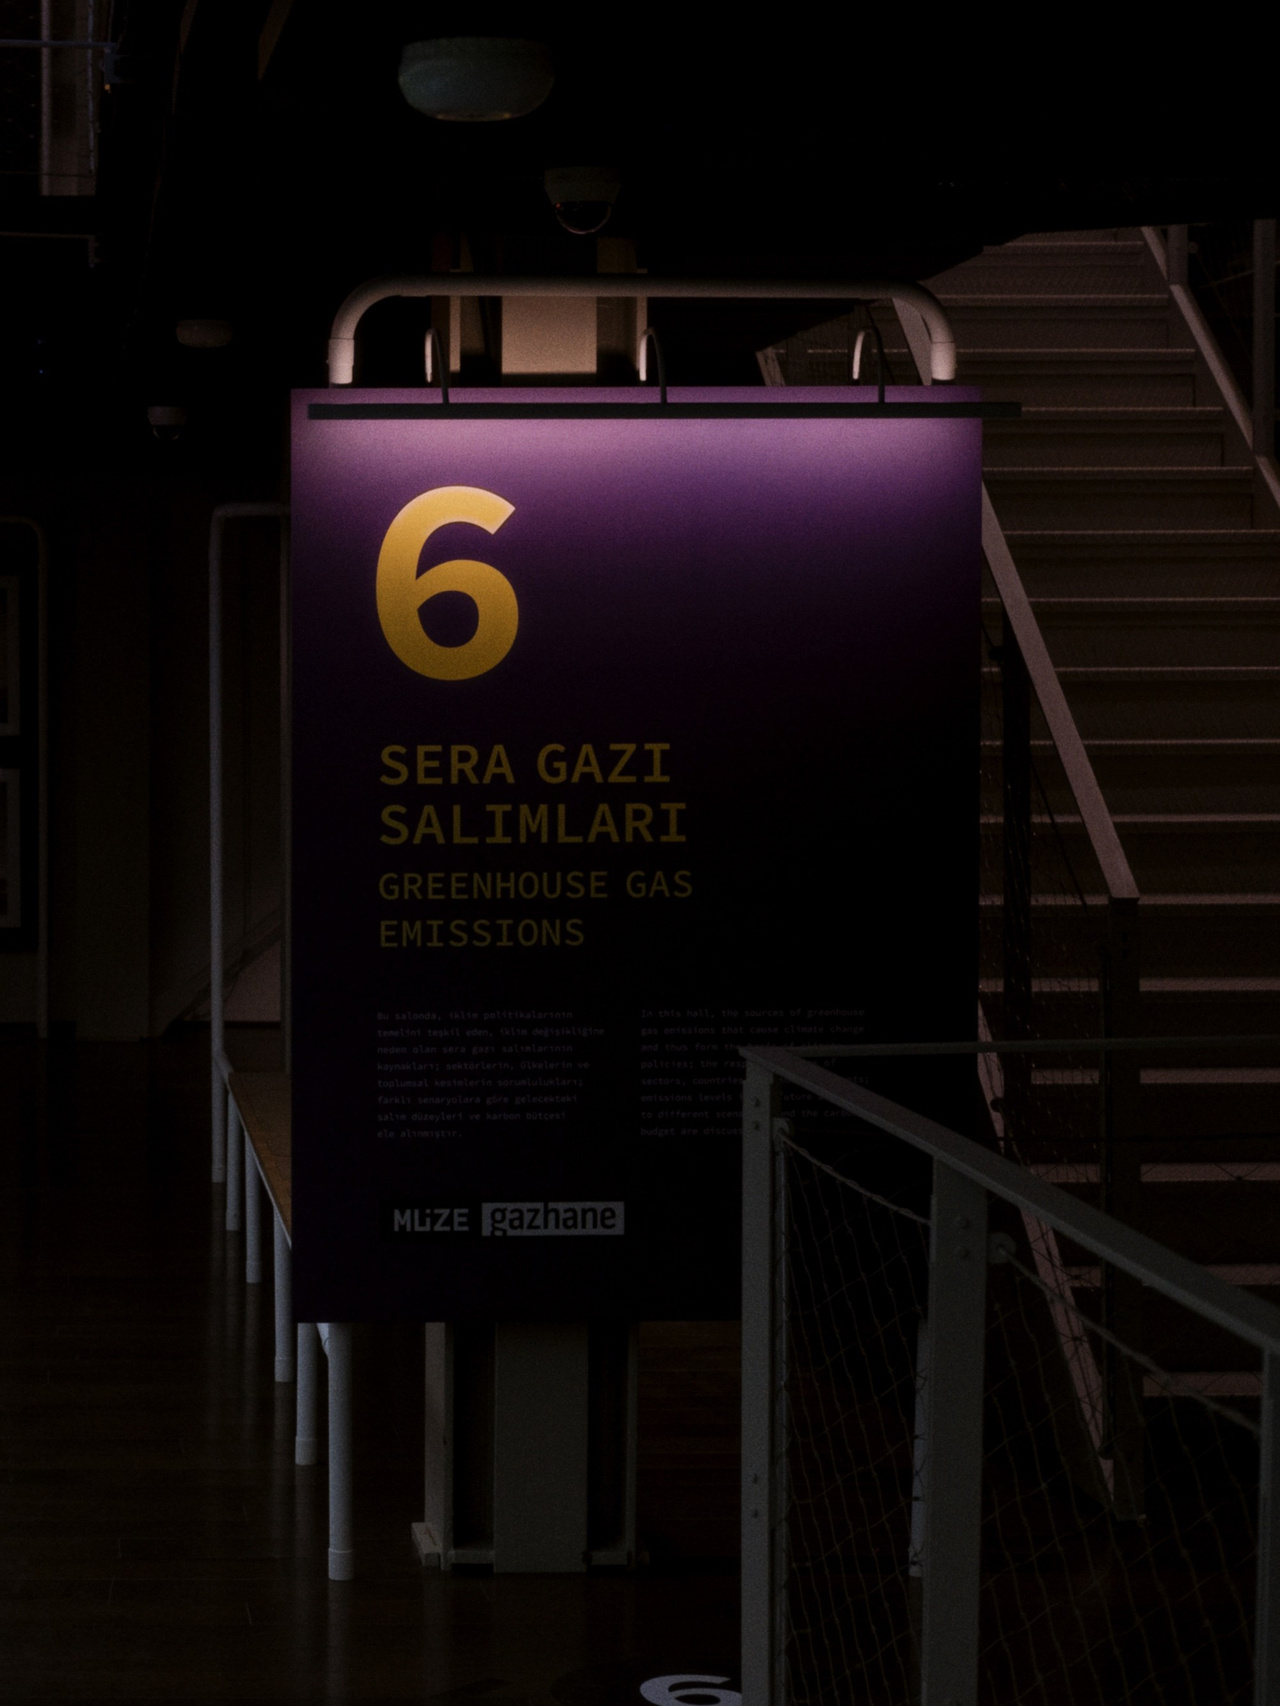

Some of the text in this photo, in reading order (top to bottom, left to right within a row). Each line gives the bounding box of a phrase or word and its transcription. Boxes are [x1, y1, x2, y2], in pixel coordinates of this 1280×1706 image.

[375, 485, 519, 682] 6
[379, 742, 671, 785] SERA GAZI
[379, 802, 687, 845] SALIMLARI
[378, 870, 693, 901] GREENHOUSE GAS
[380, 918, 585, 948] EMISSIONS
[377, 1011, 573, 1022] Bu salonda, iklim politikalarının
[640, 1009, 653, 1018] In
[658, 1009, 682, 1018] this
[686, 1009, 716, 1019] hall,
[790, 1008, 802, 1017] of
[807, 1008, 865, 1019] greenhouse
[377, 1028, 421, 1037] temelini
[427, 1028, 460, 1039] teşkil
[466, 1028, 493, 1038] eden,
[500, 1028, 527, 1036] iklim
[640, 1025, 864, 1037] gas emissions that cause climate change
[377, 1044, 573, 1056] neden olan sera gazı salımlarının
[640, 1043, 659, 1052] and
[665, 1043, 689, 1052] thus
[694, 1043, 719, 1052] form
[377, 1062, 441, 1073] kaynakları;
[446, 1061, 514, 1071] sektörlerin,
[520, 1061, 572, 1070] ülkelerin
[640, 1059, 694, 1070] policies;
[823, 1059, 836, 1067] of
[377, 1079, 428, 1089] toplumsal
[434, 1079, 492, 1088] kesimlerin
[640, 1076, 686, 1087] sectors,
[377, 1095, 577, 1107] farklı senaryolara göre gelecekteki
[640, 1093, 813, 1103] emissions levels uture
[377, 1111, 566, 1123] salım düzeyleri ve karbon bütçesi
[640, 1110, 653, 1119] to
[658, 1109, 709, 1119] different
[377, 1129, 462, 1140] ele alınmıştır.
[640, 1127, 675, 1137] budget
[681, 1128, 699, 1136] are
[490, 1201, 617, 1236] gazhane
[639, 1673, 742, 1706] 6
